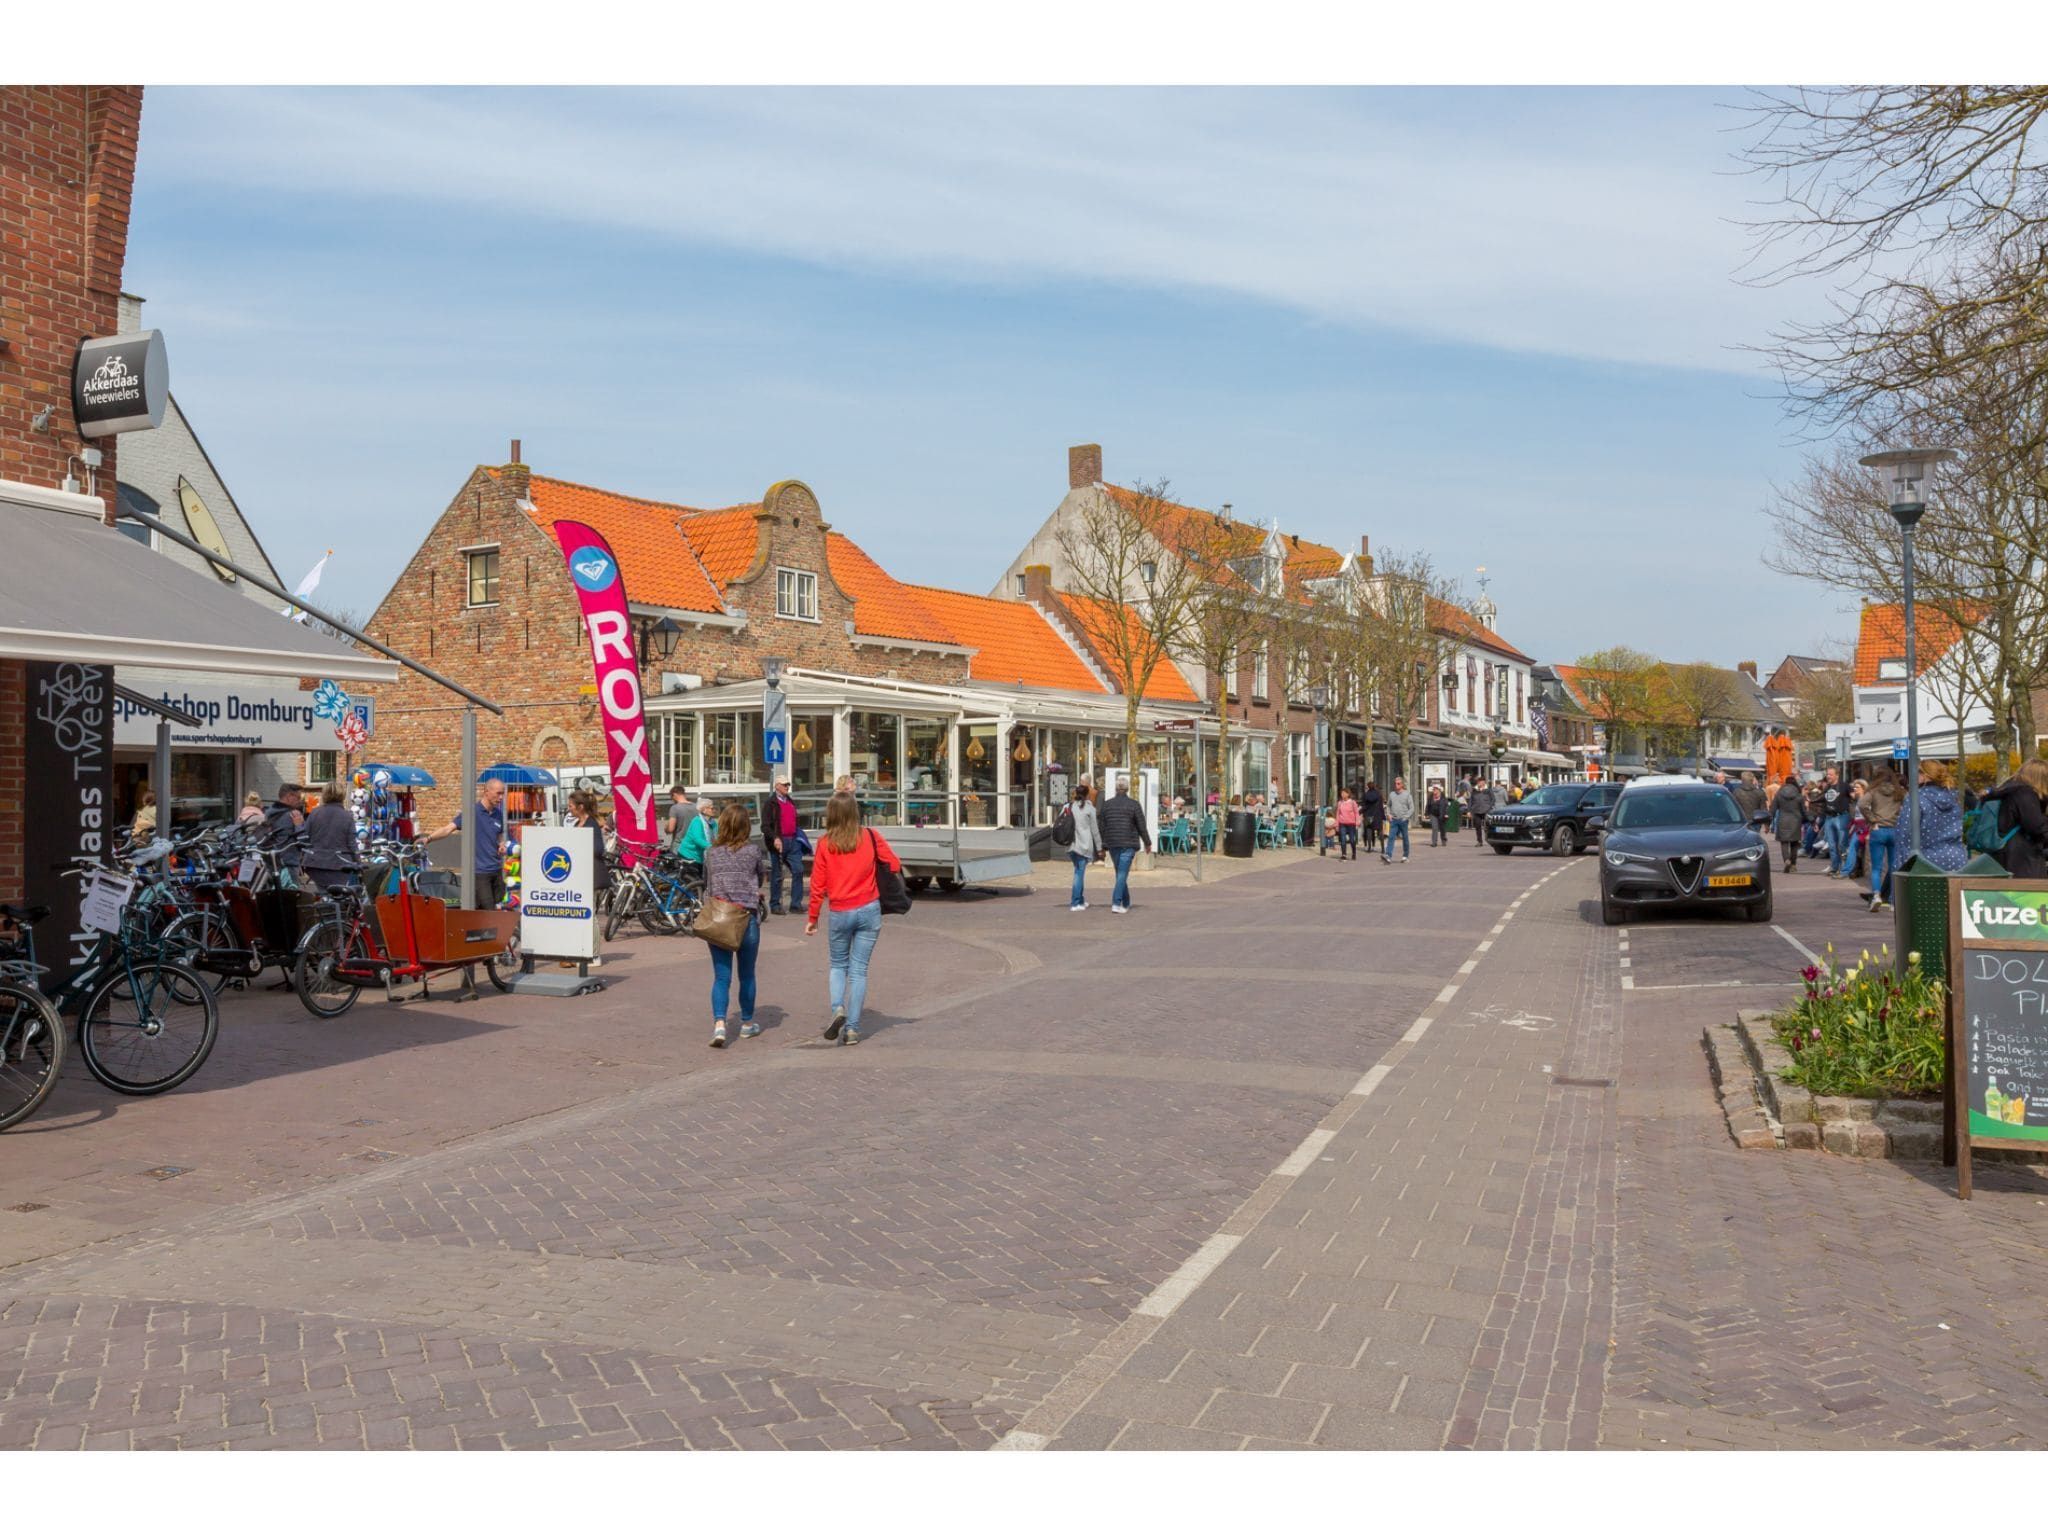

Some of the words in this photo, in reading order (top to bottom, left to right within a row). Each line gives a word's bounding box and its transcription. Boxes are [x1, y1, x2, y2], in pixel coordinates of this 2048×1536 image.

[83, 374, 138, 393] Akkerdaas
[83, 387, 139, 405] Tweewielers
[227, 694, 314, 730] Domburg
[587, 609, 652, 831] ROXY
[171, 733, 262, 746] www.sportshopdomburg.nl
[530, 889, 582, 902] Gazelle
[526, 906, 587, 917] VERHUURPUNT
